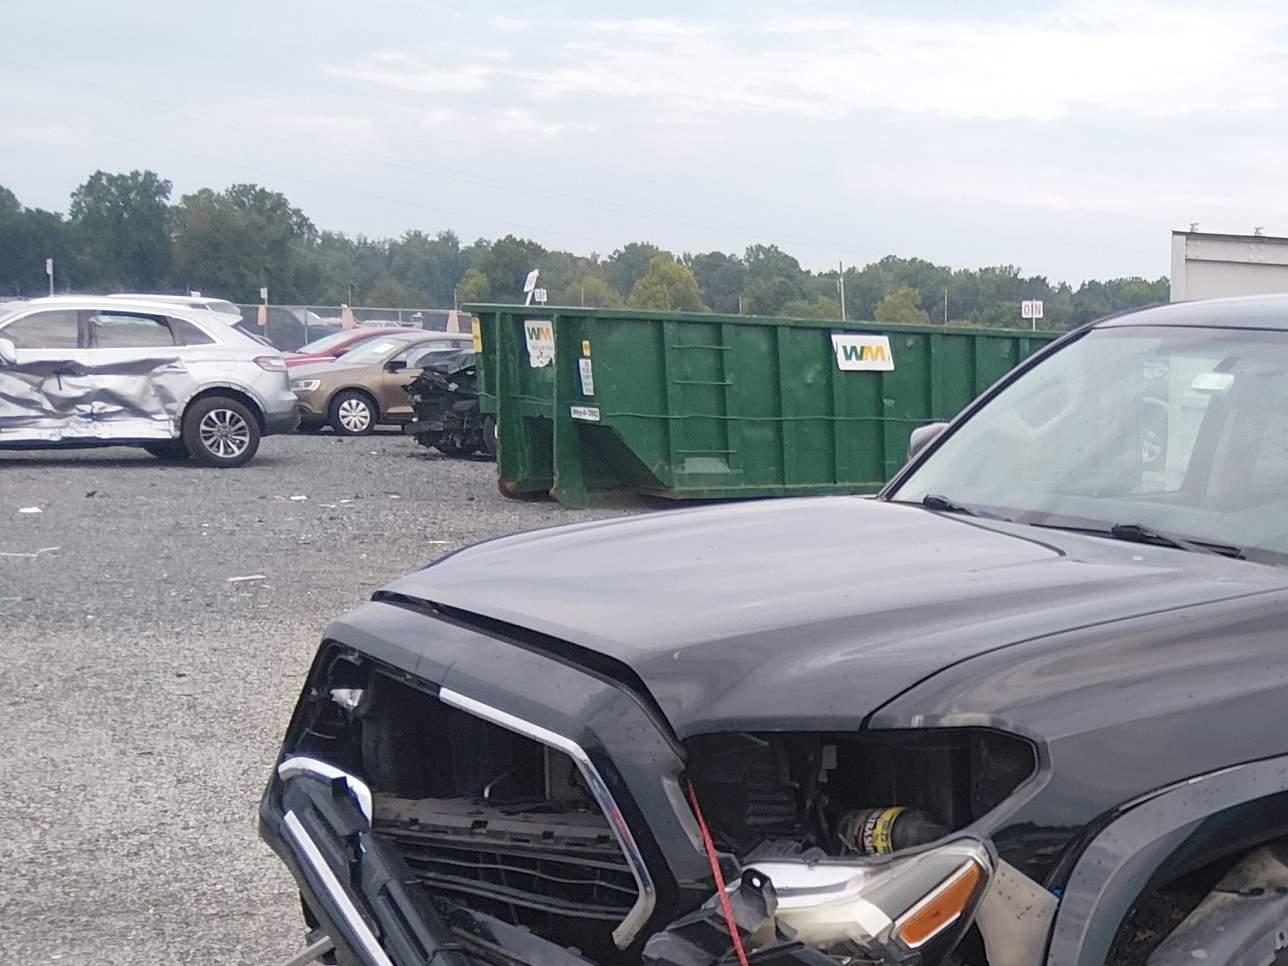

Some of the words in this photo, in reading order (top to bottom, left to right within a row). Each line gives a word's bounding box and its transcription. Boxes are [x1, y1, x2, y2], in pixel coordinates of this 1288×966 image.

[1034, 304, 1042, 316] N
[527, 326, 552, 341] WM
[841, 344, 887, 362] WM
